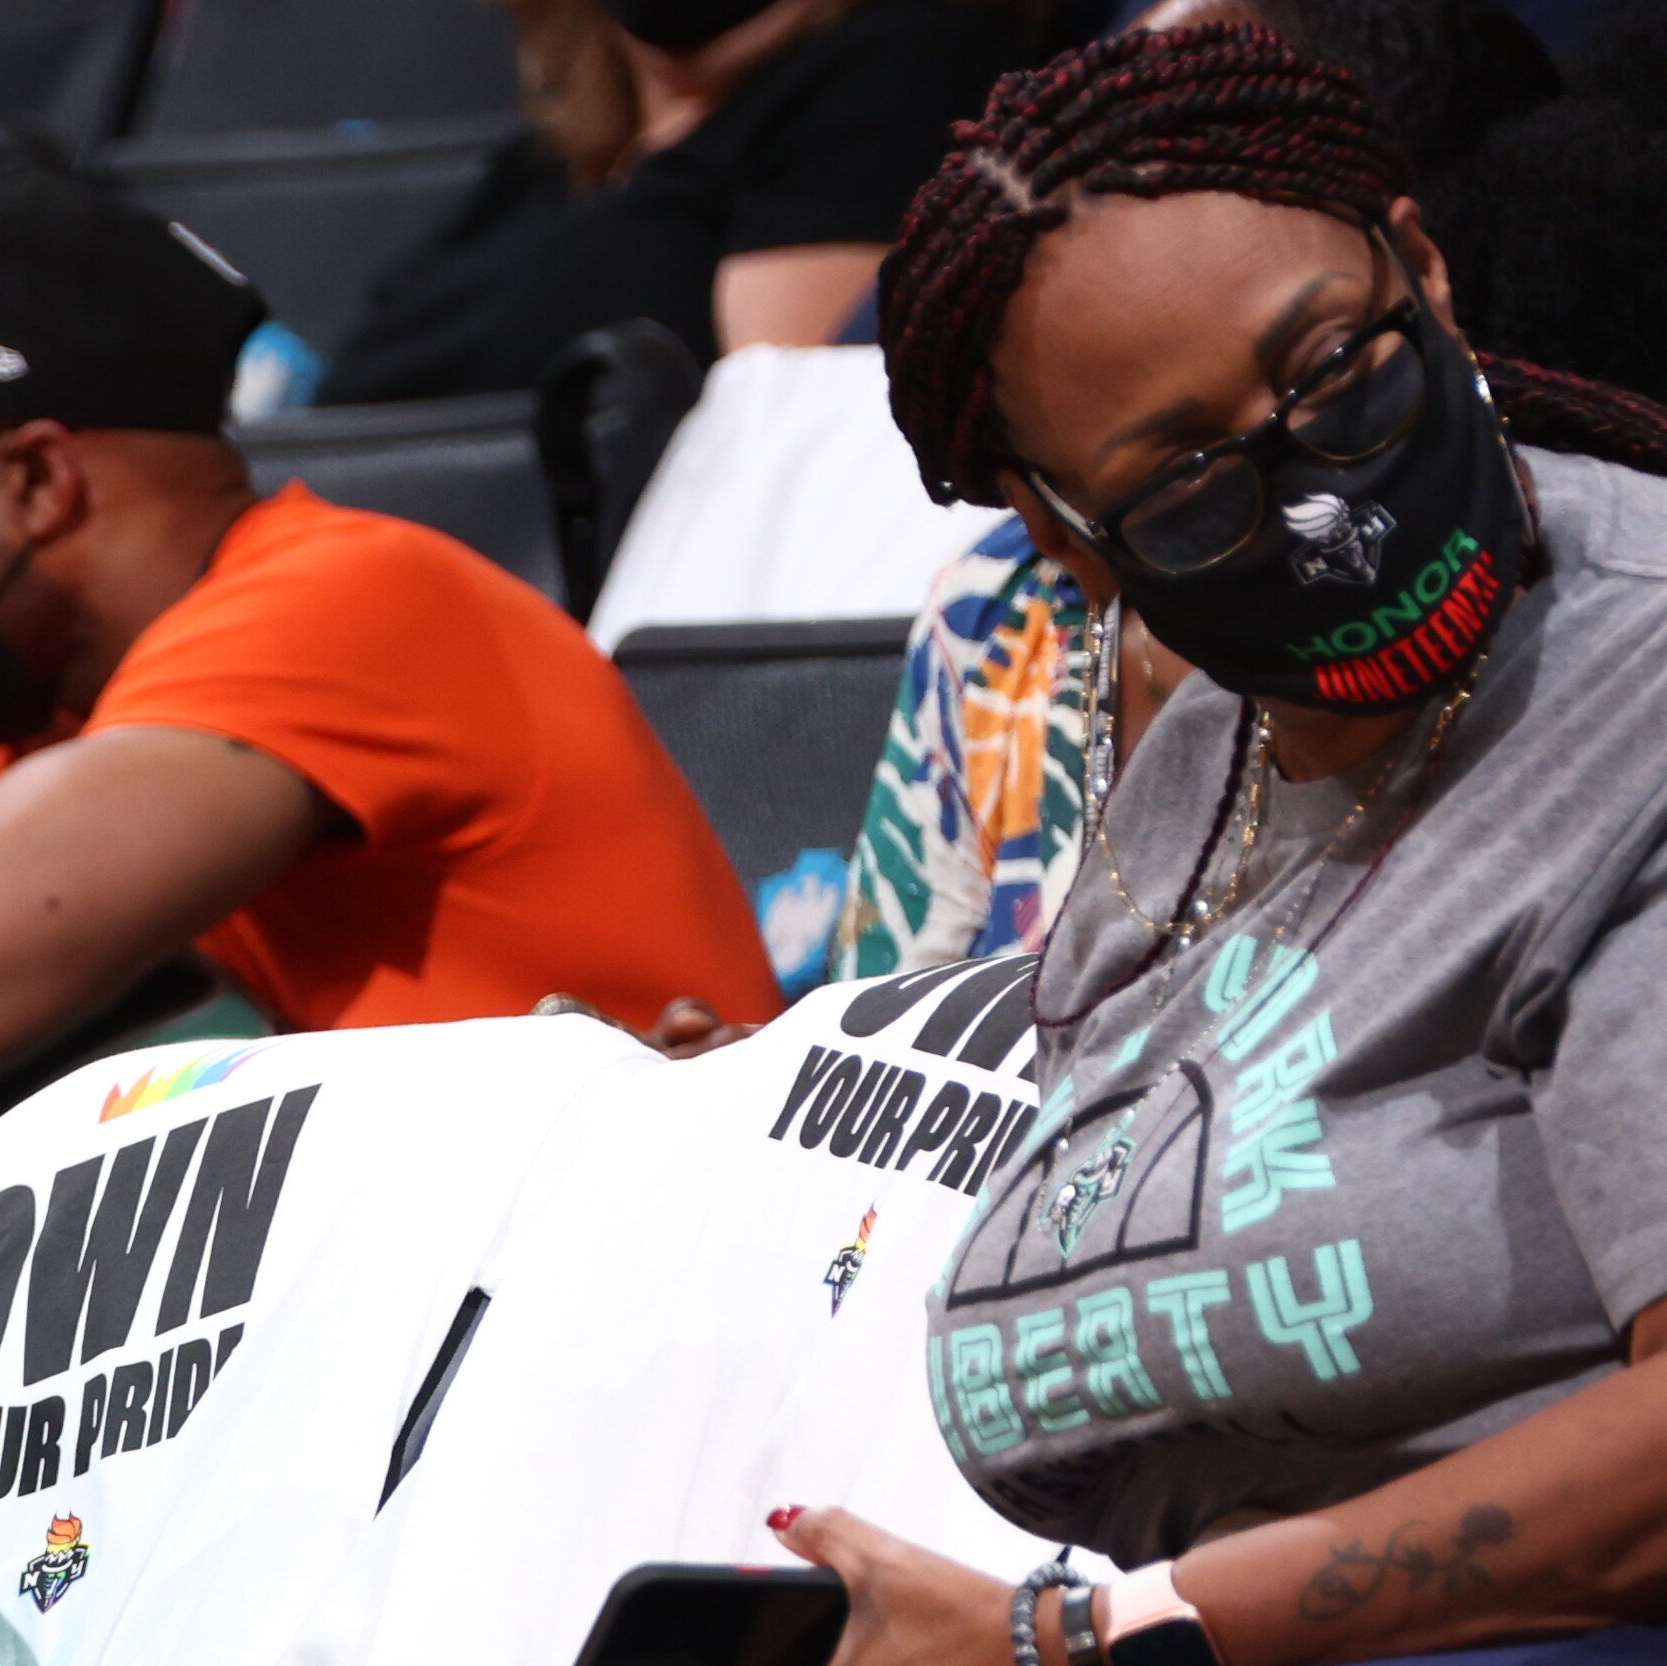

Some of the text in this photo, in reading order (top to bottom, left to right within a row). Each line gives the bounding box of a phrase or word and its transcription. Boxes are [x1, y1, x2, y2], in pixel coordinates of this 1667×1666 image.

[1286, 527, 1479, 661] HONOR
[768, 1044, 927, 1170] YOUR
[929, 1238, 1373, 1468] IBERTY
